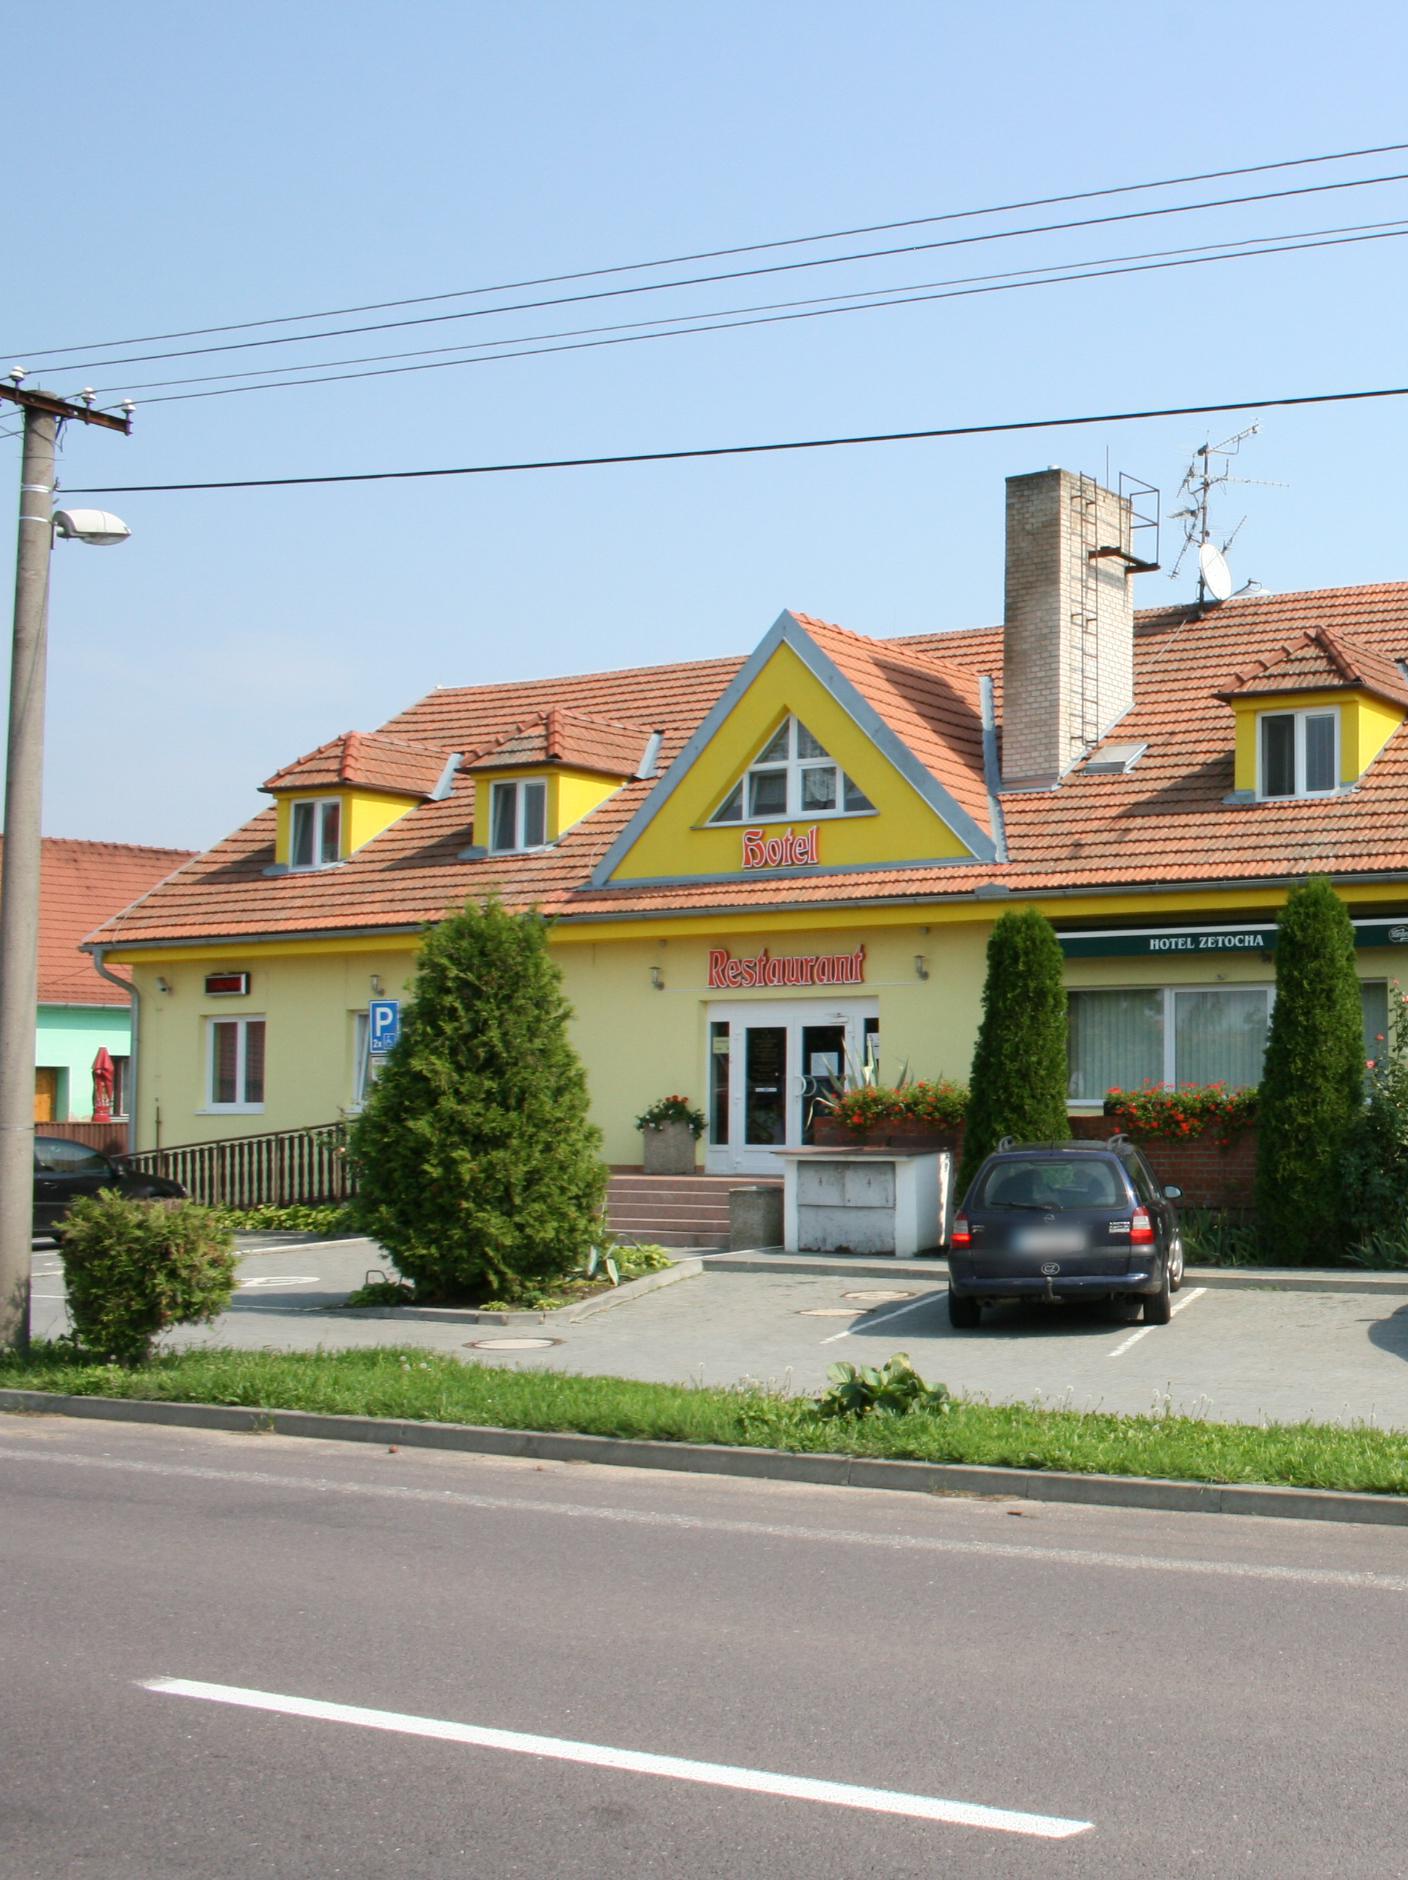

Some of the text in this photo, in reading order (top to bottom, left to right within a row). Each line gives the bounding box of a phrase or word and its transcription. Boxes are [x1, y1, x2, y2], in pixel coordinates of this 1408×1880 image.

[742, 825, 819, 868] Hotel
[1149, 935, 1264, 950] HOTEL ZETOCHA
[708, 944, 865, 988] Restaurant
[376, 1007, 393, 1036] P
